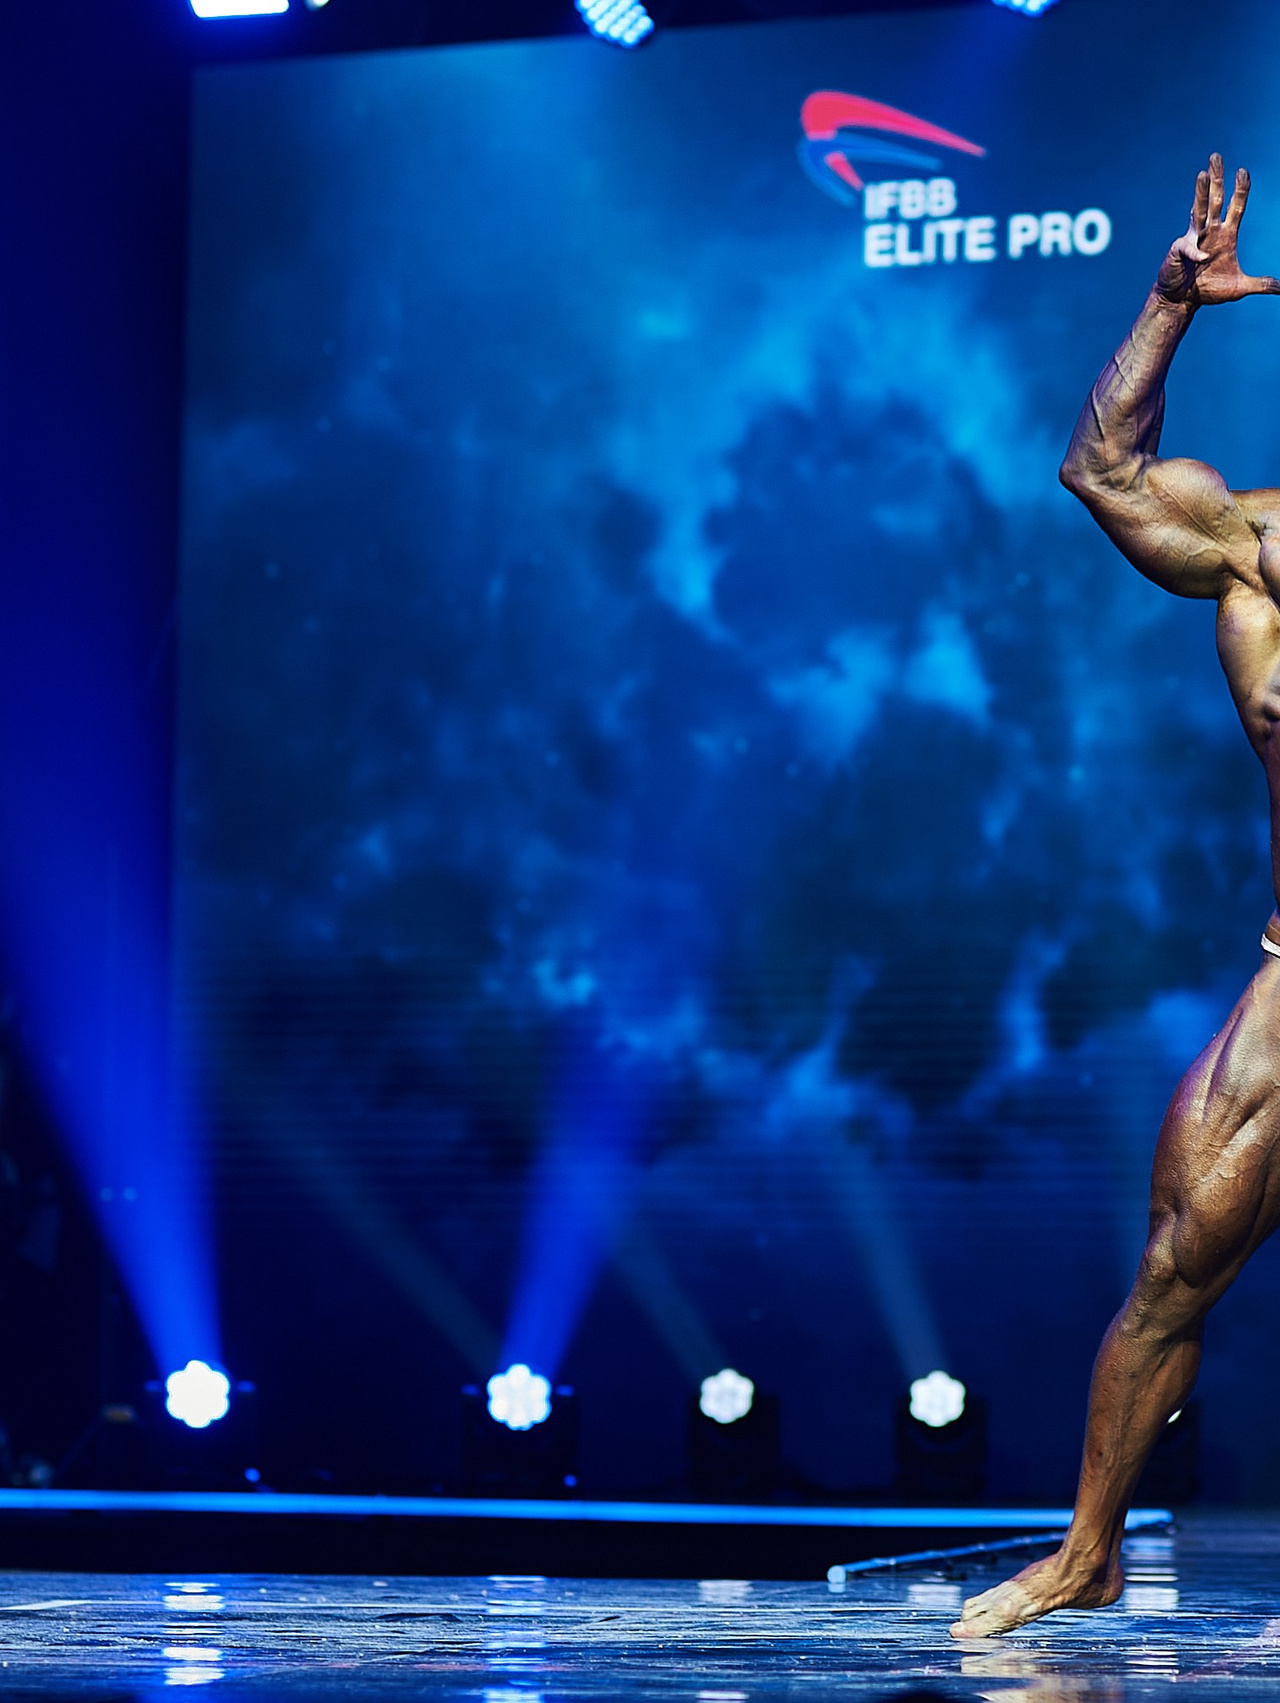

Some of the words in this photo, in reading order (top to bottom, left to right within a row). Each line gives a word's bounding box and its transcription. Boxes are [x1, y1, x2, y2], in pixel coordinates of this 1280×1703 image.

[864, 177, 957, 220] IFBB
[864, 217, 997, 268] ELITE
[1008, 208, 1112, 259] PRO
